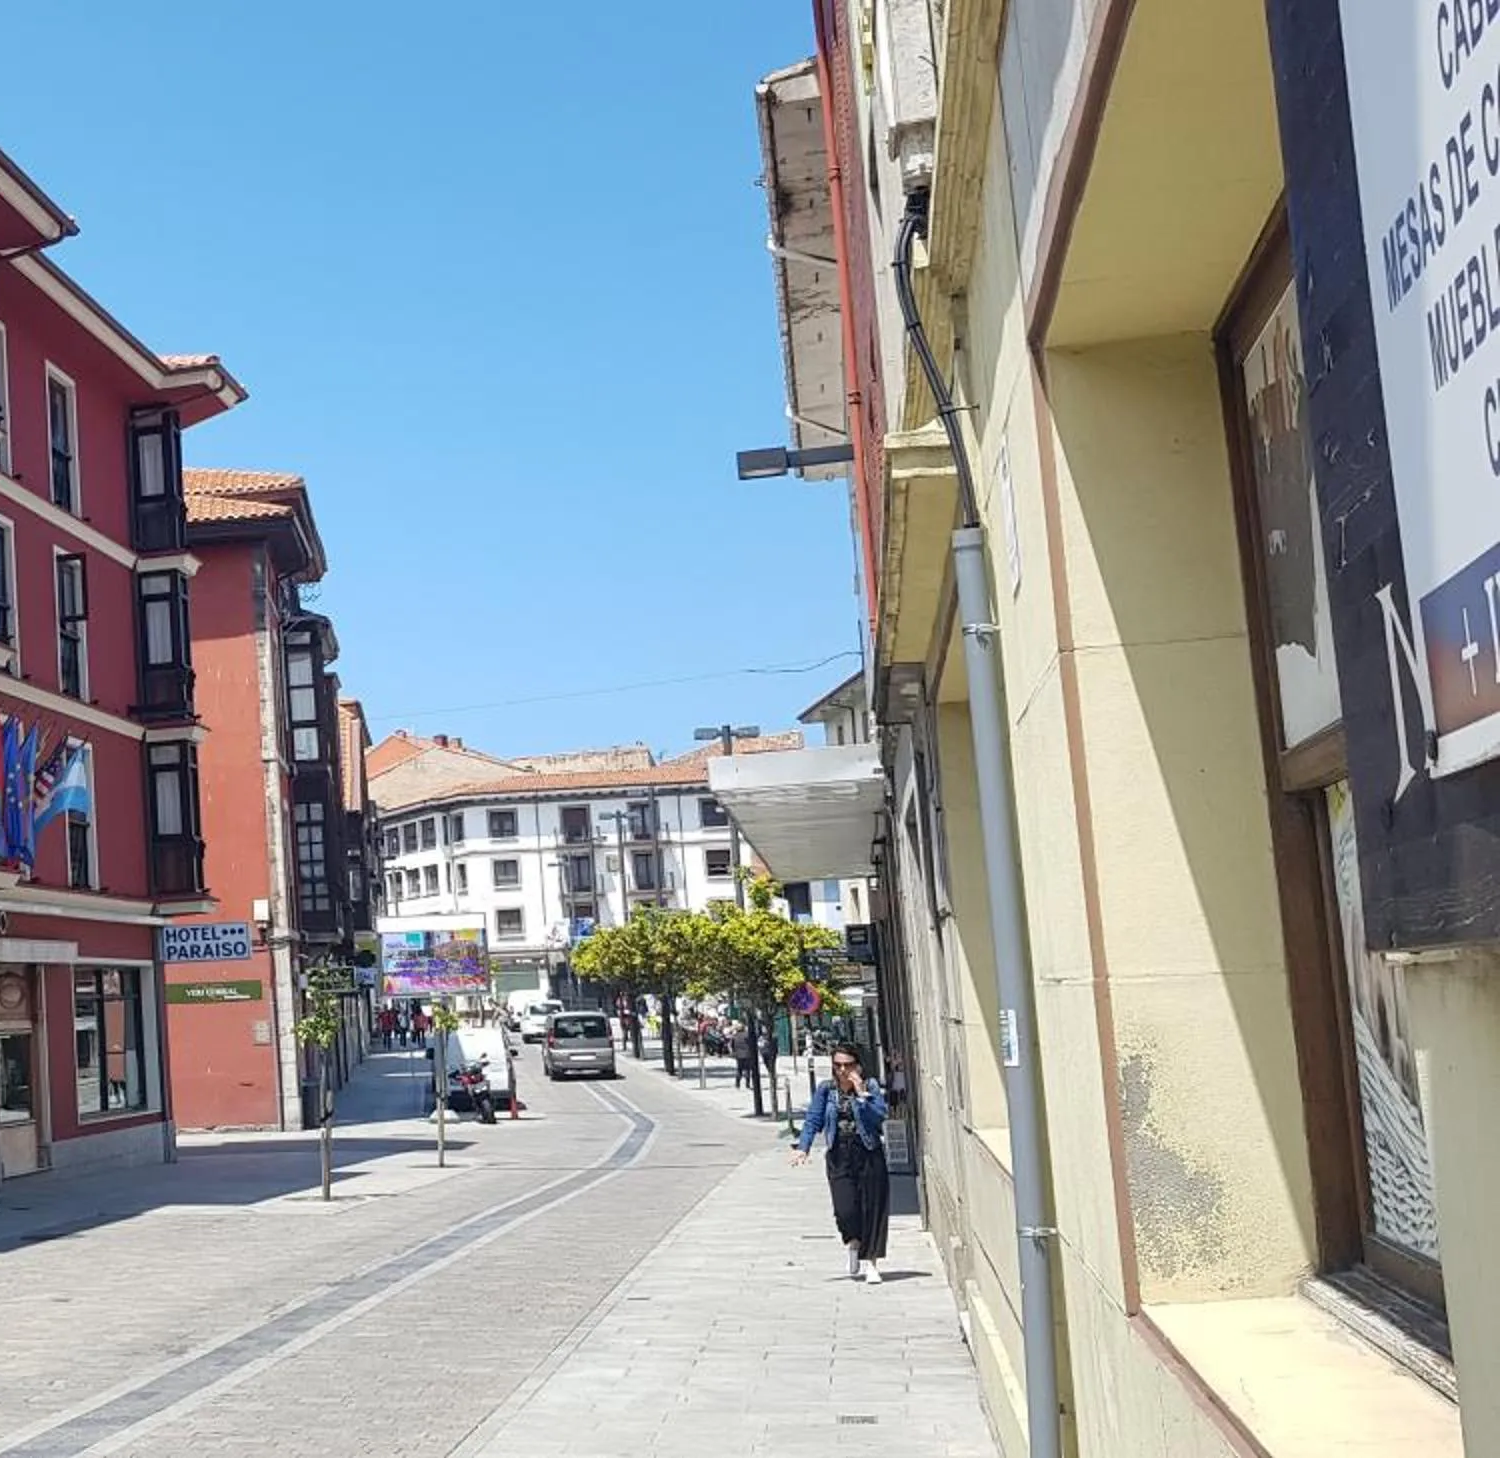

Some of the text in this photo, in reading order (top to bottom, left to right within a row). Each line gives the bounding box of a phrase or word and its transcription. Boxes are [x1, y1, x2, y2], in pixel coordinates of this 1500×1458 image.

[1382, 161, 1446, 313] MESAS
[1446, 109, 1480, 226] DE
[165, 926, 220, 943] HOTEL
[166, 941, 247, 960] PARAISO
